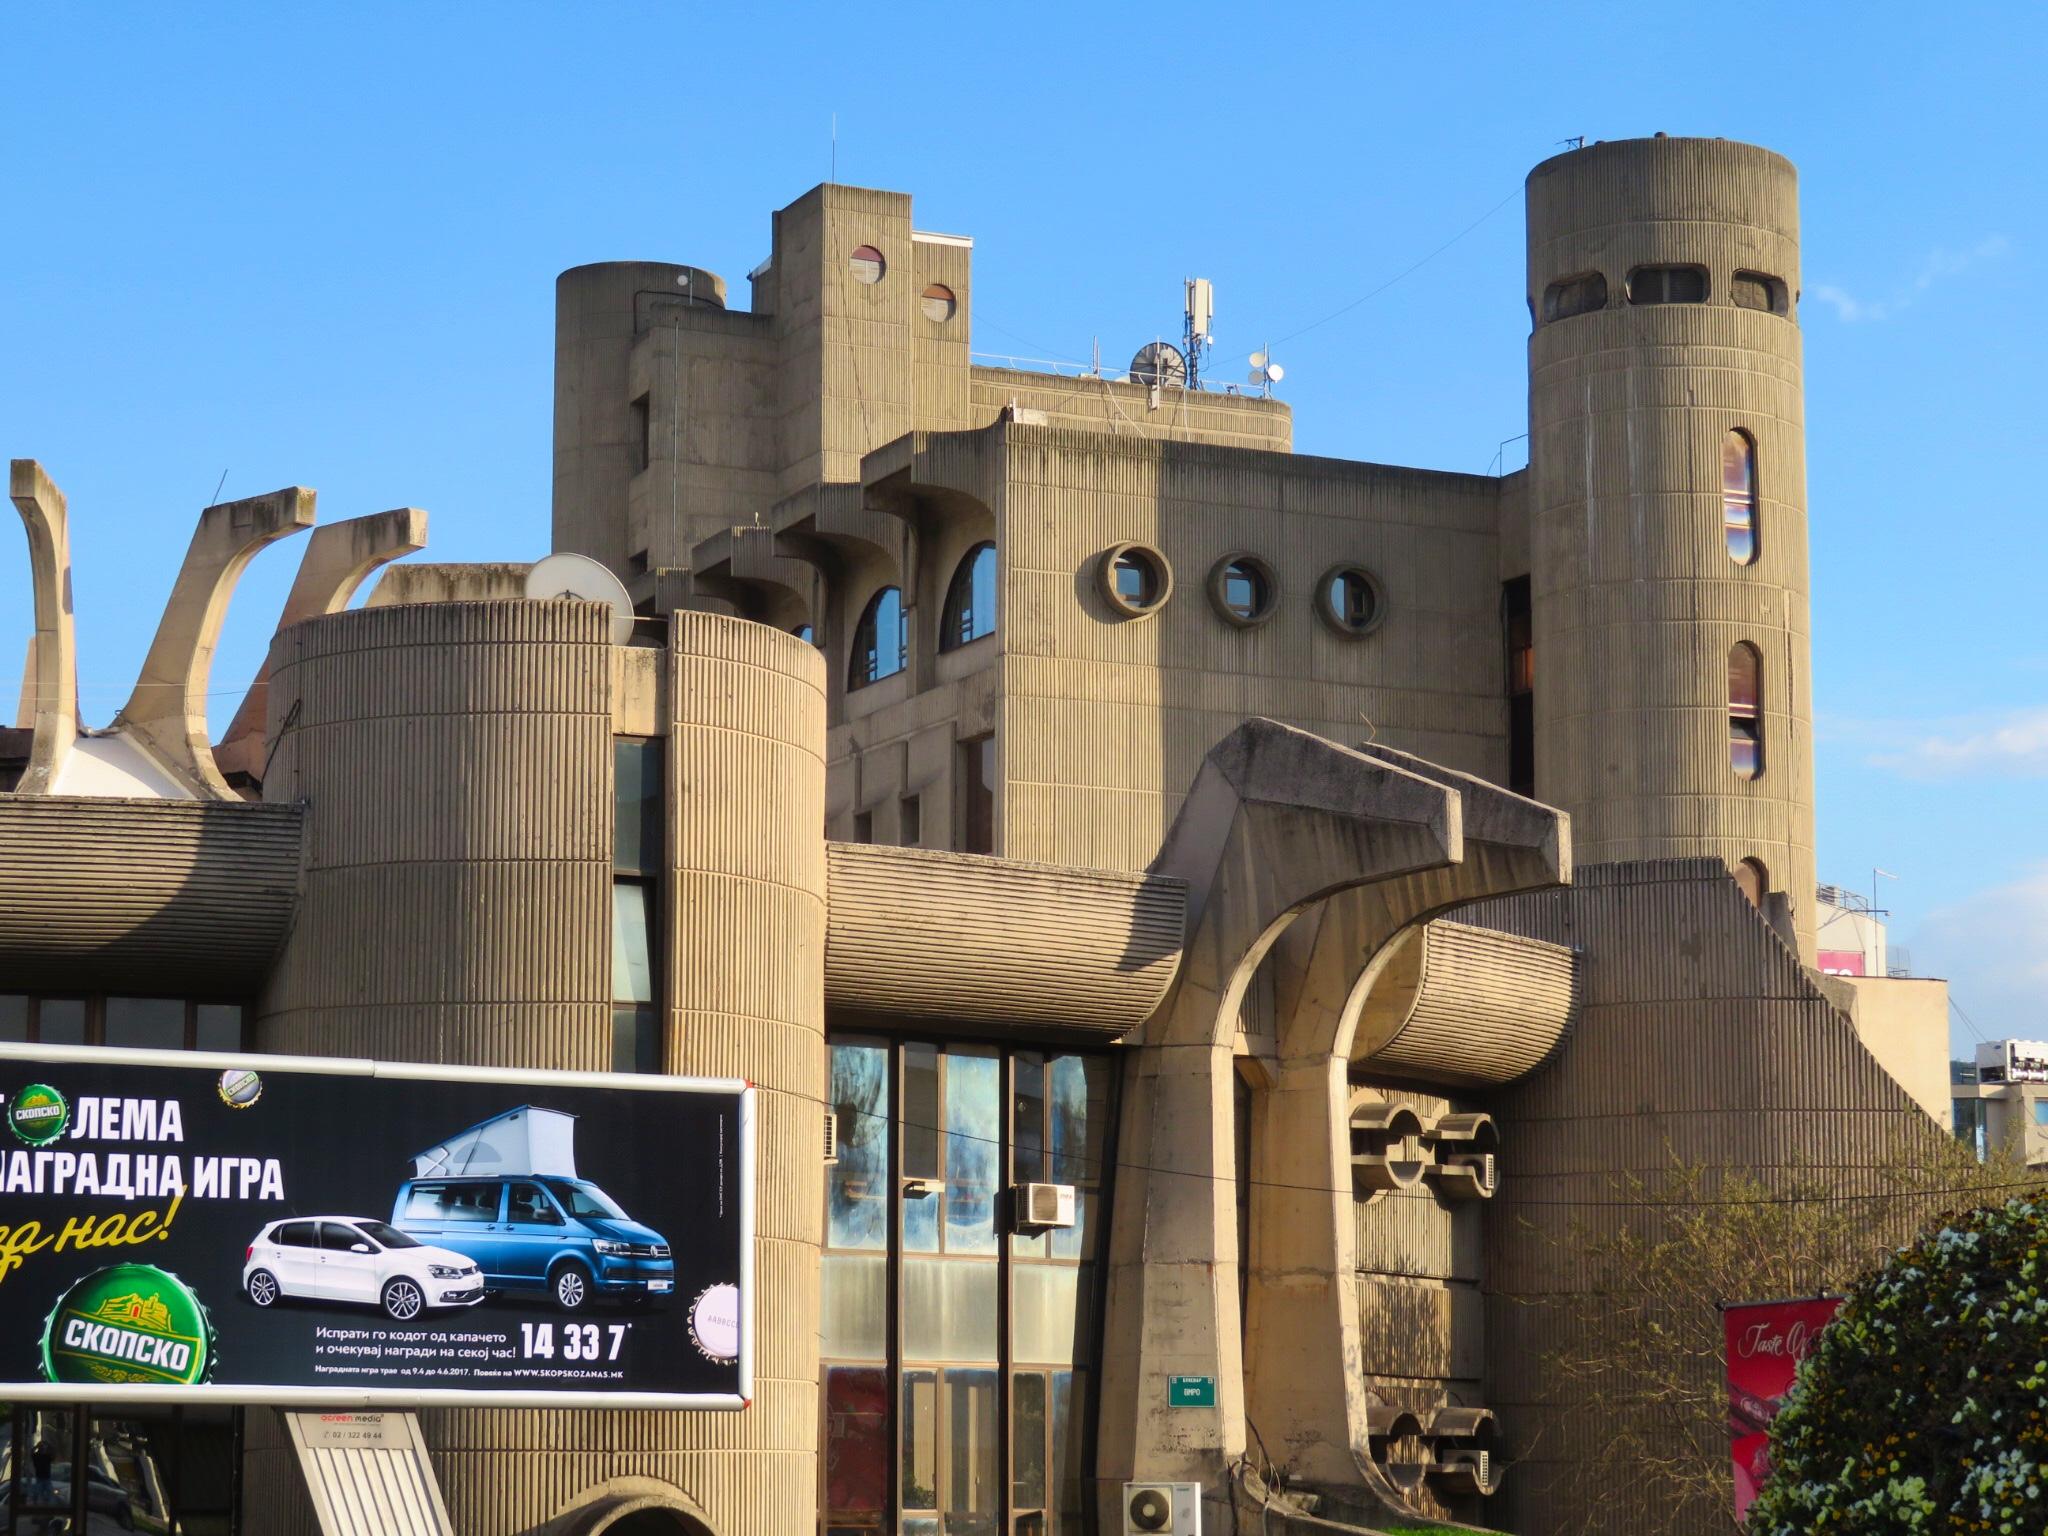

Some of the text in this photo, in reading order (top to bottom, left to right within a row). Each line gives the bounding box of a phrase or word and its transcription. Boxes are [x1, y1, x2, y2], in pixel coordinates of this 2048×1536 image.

[15, 1105, 60, 1120] СКОПСКО
[70, 1096, 184, 1142] ЛЕМА
[193, 1157, 285, 1201] ИГРА
[54, 1184, 188, 1253] нас!
[64, 1318, 191, 1371] СКОПСКО
[315, 1345, 516, 1361] и очекувај награди на секој час!
[316, 1327, 507, 1344] Испрати го кодот од капачето
[521, 1323, 554, 1359] 14
[563, 1324, 600, 1360] 33
[1738, 1322, 1784, 1358] Taste
[315, 1365, 360, 1374] Наградната
[361, 1367, 379, 1375] игра
[400, 1368, 412, 1376] од
[412, 1367, 425, 1376] 9.4
[514, 1369, 624, 1379] WWW.SKOPSKOZANAS.MK
